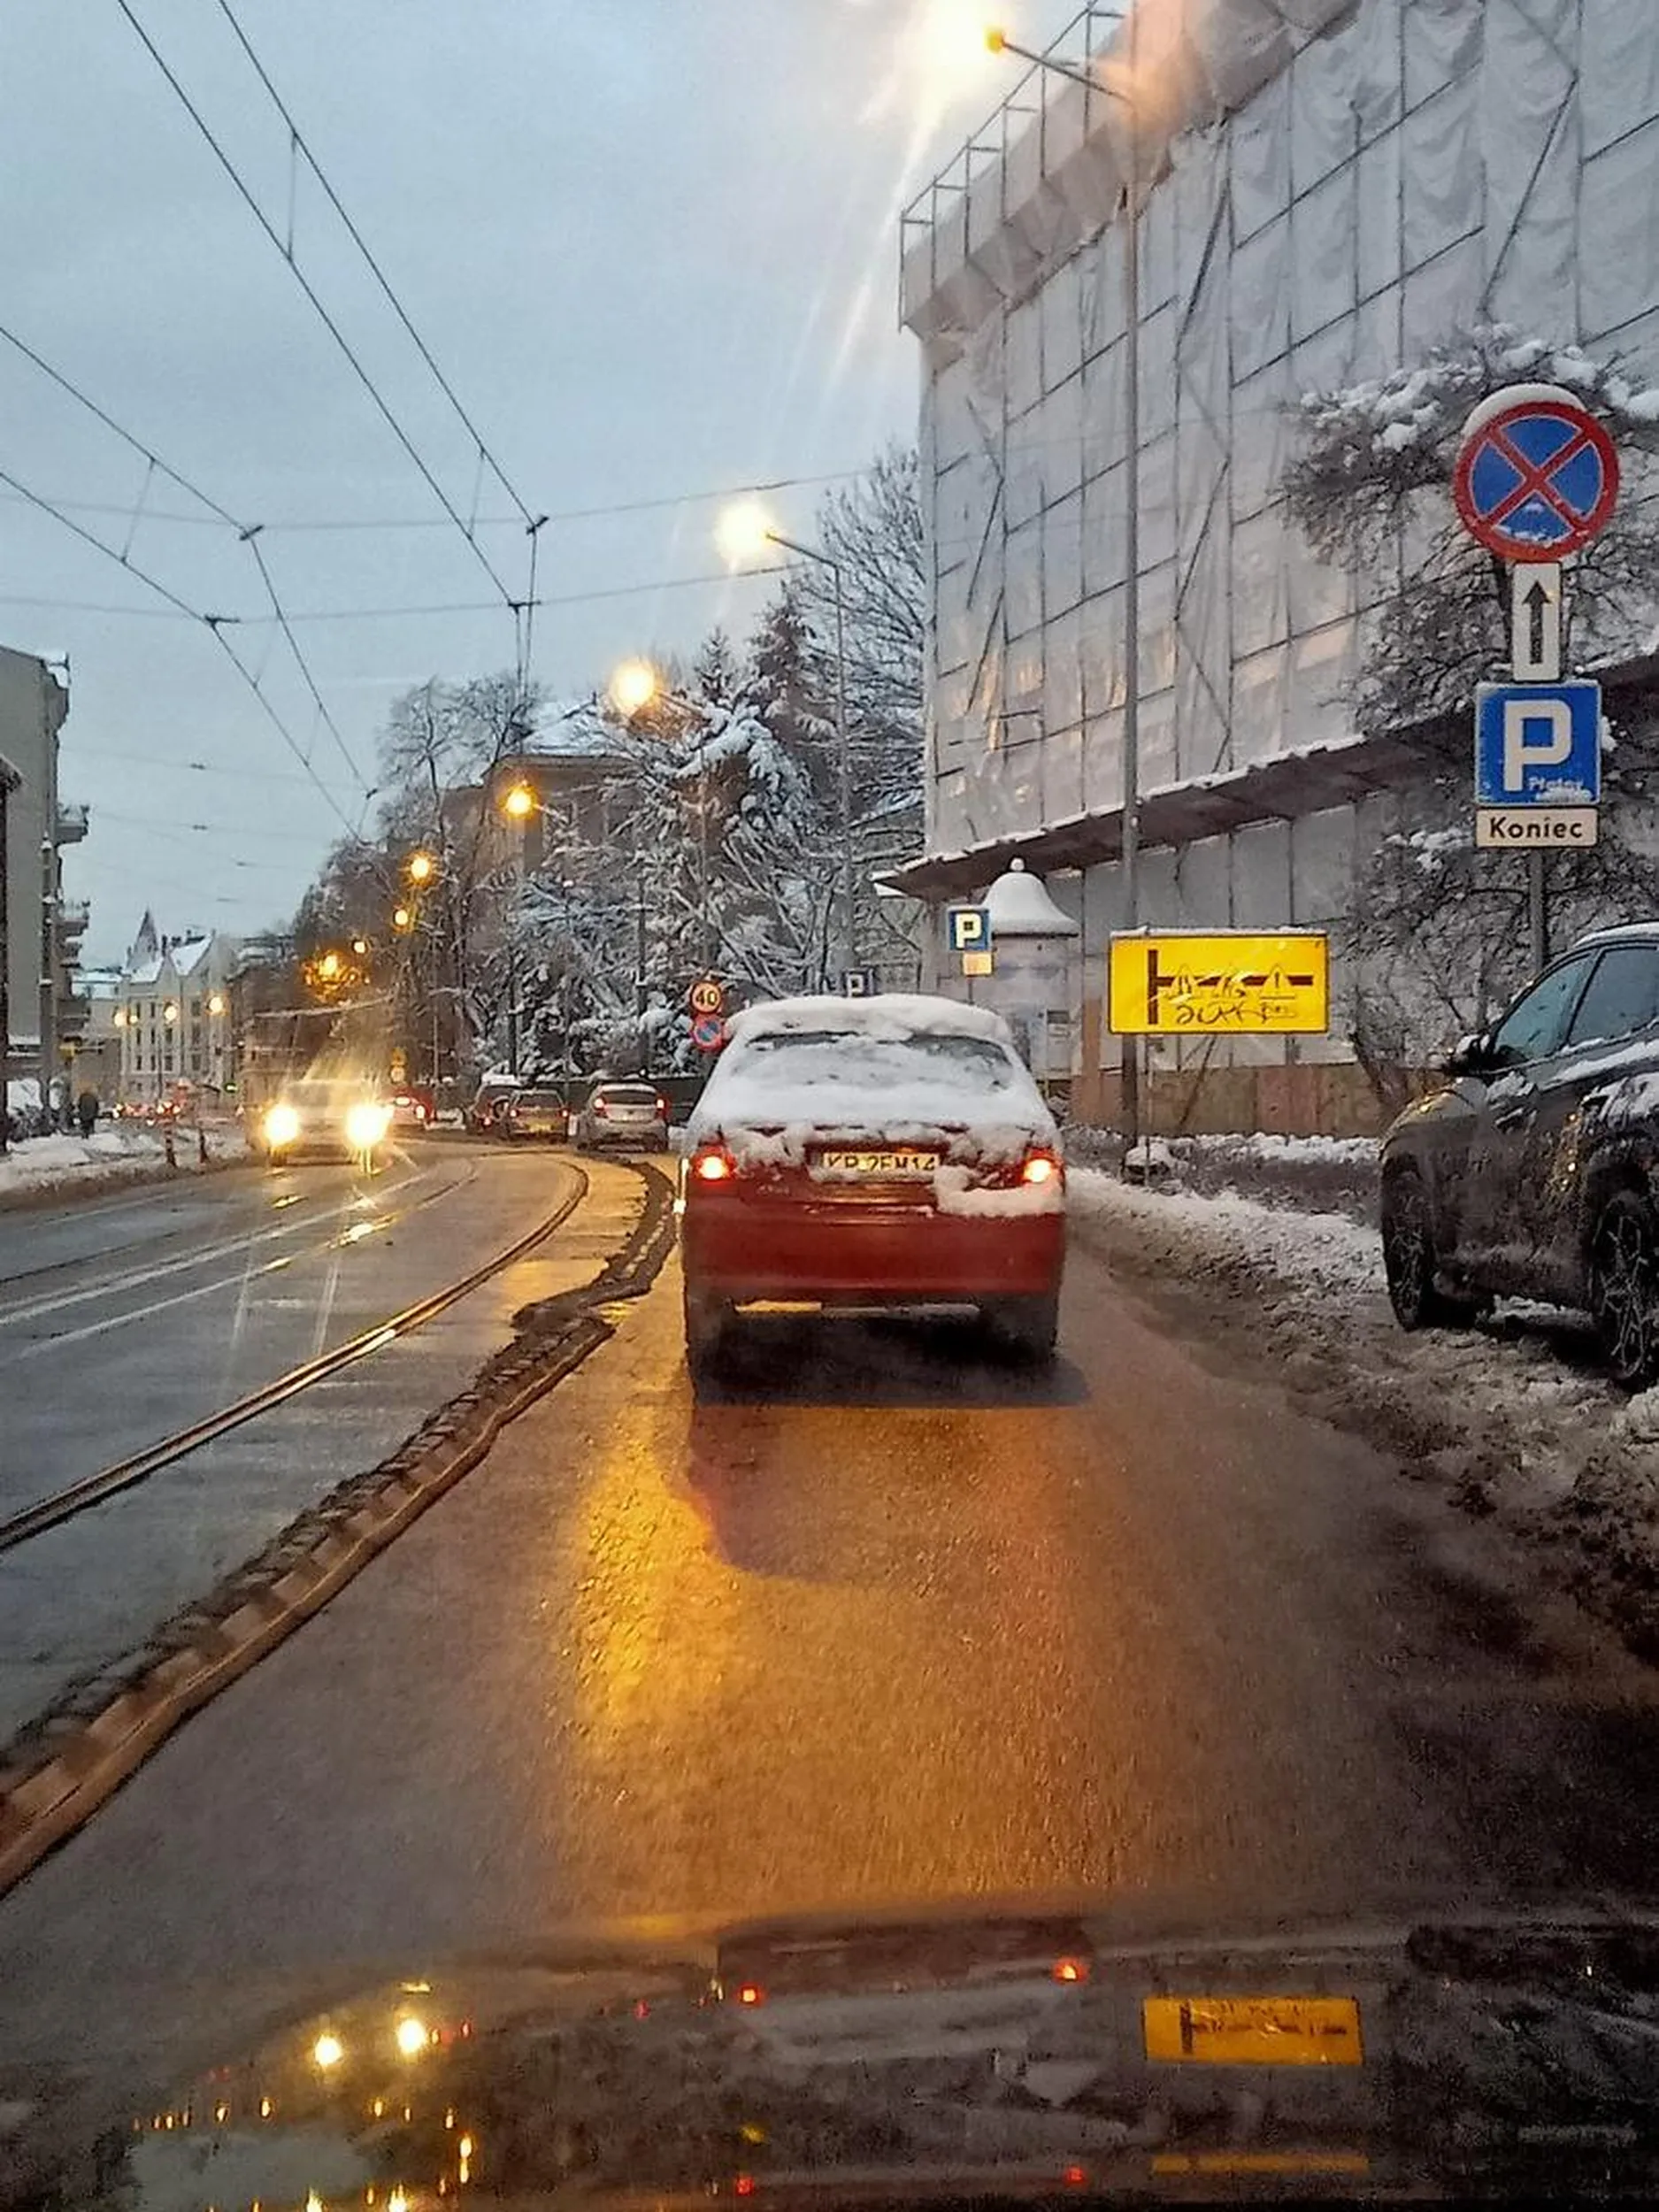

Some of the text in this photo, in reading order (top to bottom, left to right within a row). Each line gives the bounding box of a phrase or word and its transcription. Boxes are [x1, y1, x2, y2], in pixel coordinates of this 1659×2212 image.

[1503, 699, 1573, 792] P
[1489, 816, 1583, 839] Koniec
[955, 912, 982, 950] P
[845, 972, 864, 996] P
[695, 988, 718, 1006] 40
